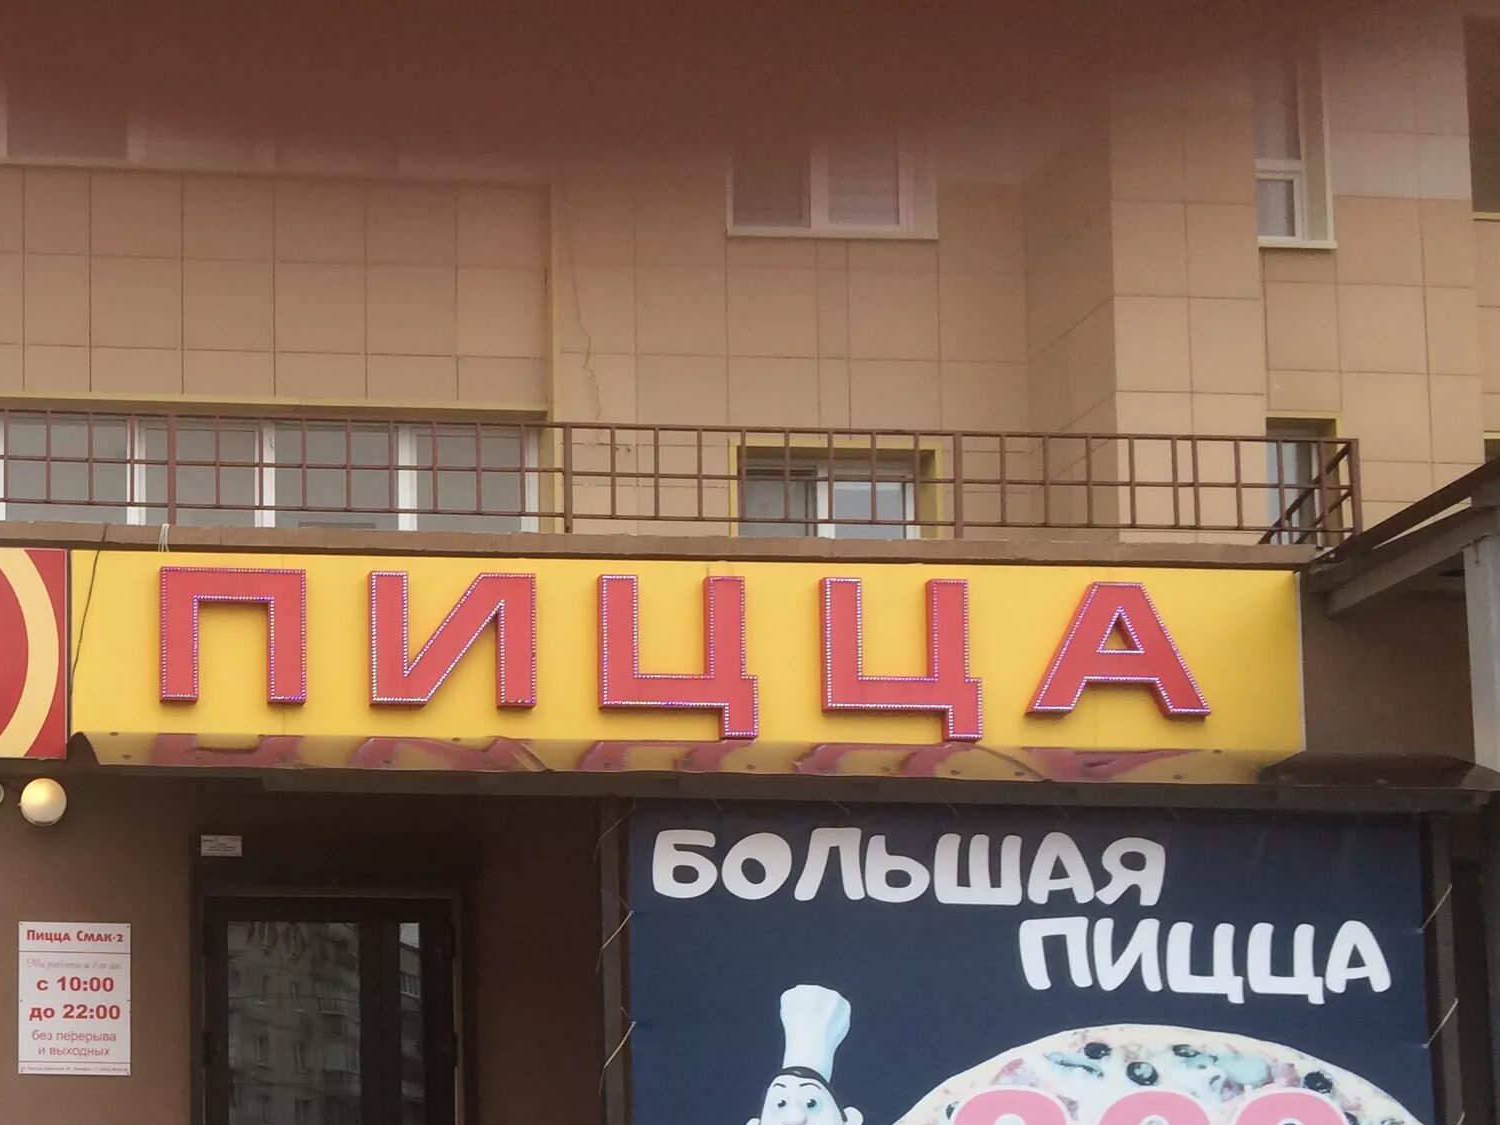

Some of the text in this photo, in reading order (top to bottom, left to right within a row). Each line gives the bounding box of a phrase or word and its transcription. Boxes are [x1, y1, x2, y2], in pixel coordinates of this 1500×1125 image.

[158, 565, 1211, 742] ПИЦЦА
[651, 826, 1167, 907] БОЛЬШАЯ
[26, 929, 71, 943] ПИЦЦА
[1019, 915, 1393, 1005] ПИЦЦА
[36, 976, 115, 992] с 10:00
[29, 1004, 121, 1021] до 22:00
[32, 1029, 117, 1043] без перерыва
[38, 1046, 111, 1058] и выходных
